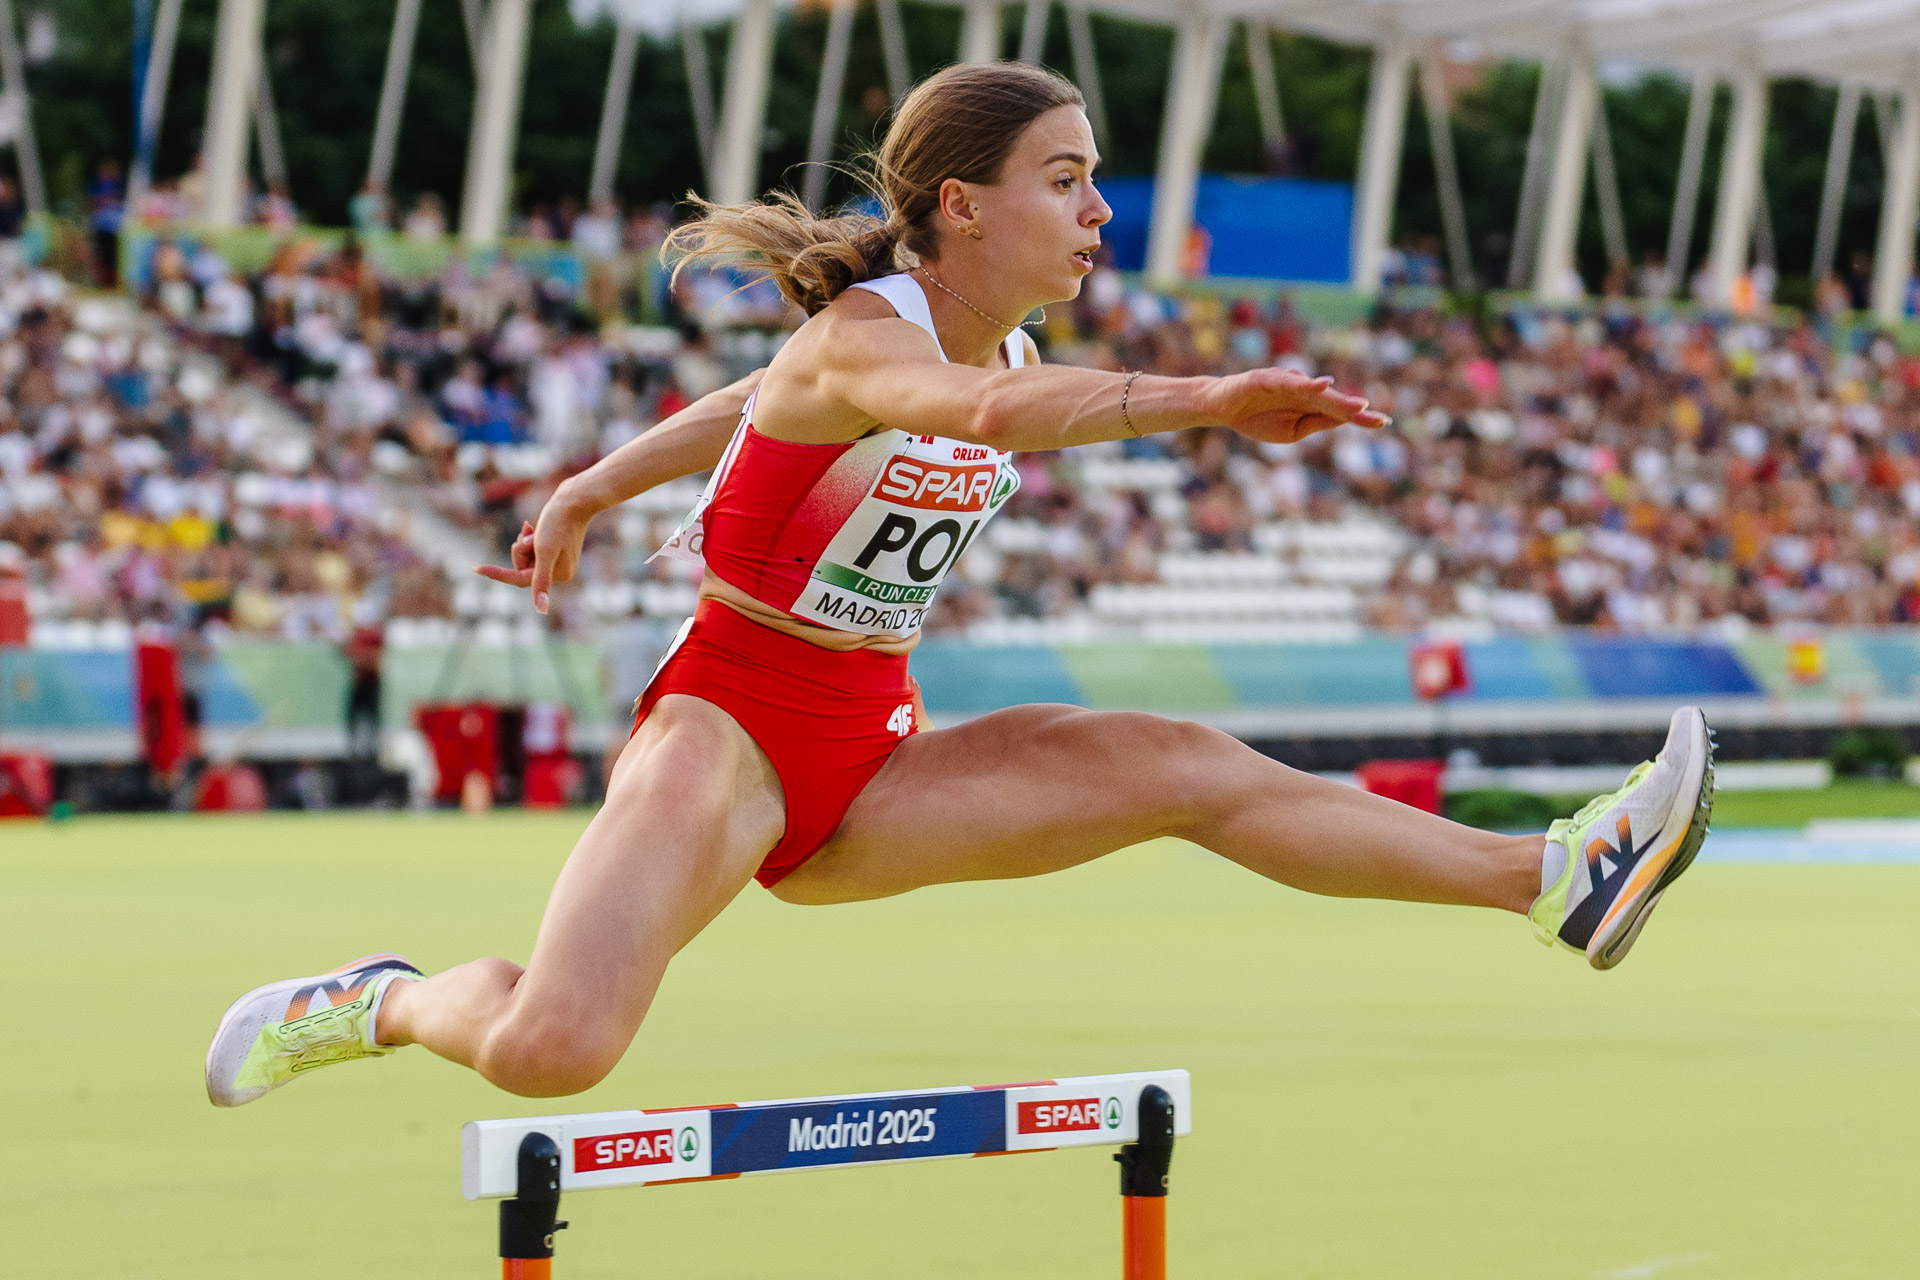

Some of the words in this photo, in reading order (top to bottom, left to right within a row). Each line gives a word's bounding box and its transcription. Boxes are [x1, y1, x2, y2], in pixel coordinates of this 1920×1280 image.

[953, 447, 988, 461] ORLEN
[881, 462, 993, 505] SPAR
[855, 577, 863, 590] I
[864, 581, 905, 602] RUN
[815, 592, 907, 630] MADRID
[886, 704, 913, 737] 4F
[788, 1110, 875, 1152] Madrid
[876, 1108, 938, 1145] 2025
[1035, 1102, 1100, 1128] SPAR
[595, 1134, 673, 1165] SPAR
